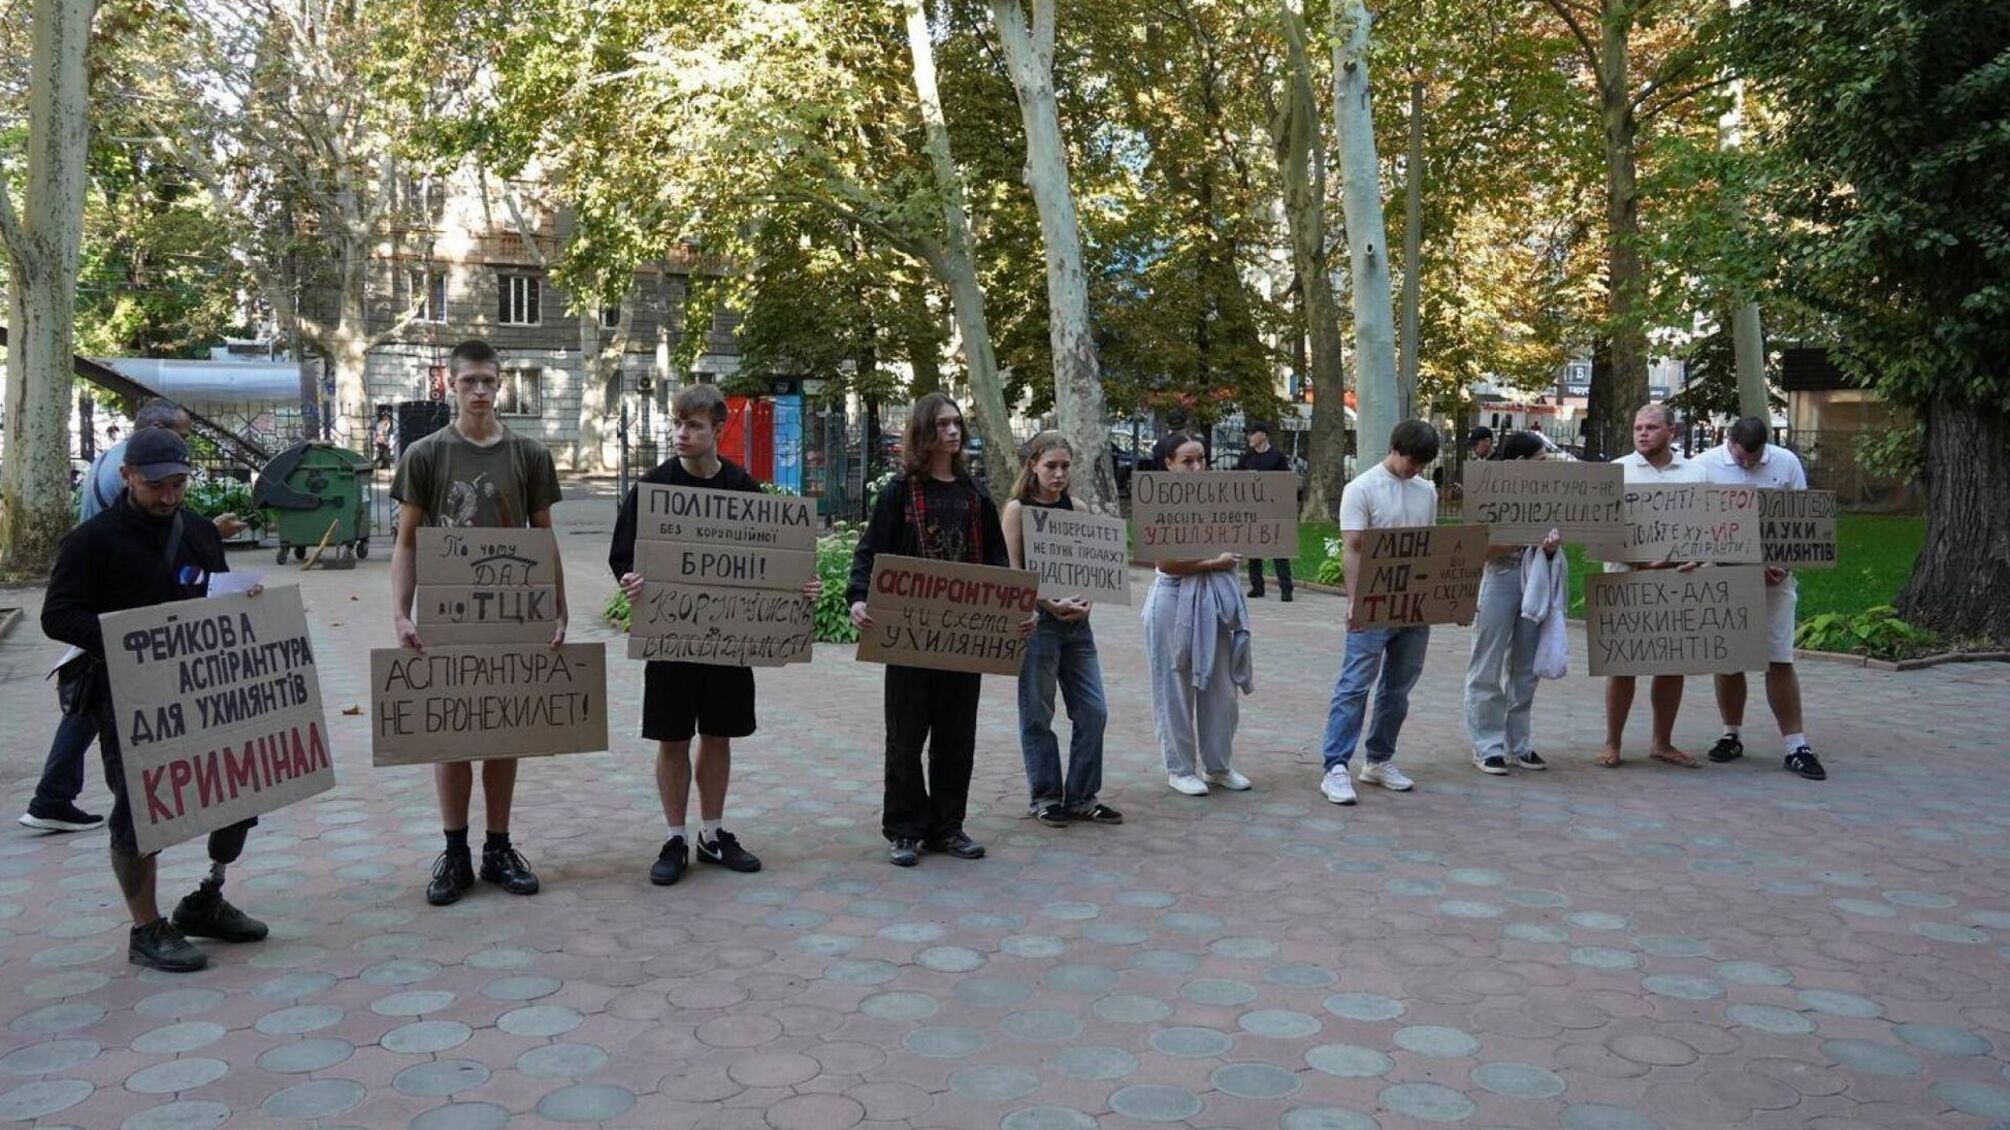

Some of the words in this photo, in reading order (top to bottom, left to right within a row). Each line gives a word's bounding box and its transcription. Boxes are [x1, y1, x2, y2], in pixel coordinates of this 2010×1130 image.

[650, 489, 810, 527] ПОЛІТЕХНІКА
[660, 523, 682, 535] БЕЗ
[697, 526, 779, 544] КОРУПЦІЙНОЇ
[681, 552, 766, 580] БРОНІ!
[472, 592, 546, 624] ТЦК
[1362, 592, 1428, 623] ТЦК
[123, 612, 256, 664] ФЕЙКОВА
[1598, 635, 1728, 664] УХИЛЯНТІВ
[179, 636, 314, 694] АСПІРАНТУРА
[130, 703, 186, 747] ДЛЯ
[195, 672, 308, 729] УХИЛЯНТІВ
[380, 700, 414, 737] НЕ
[426, 692, 590, 734] БРОНЕЖИЛЕТ!
[142, 722, 329, 825] КРИМІНАЛ
